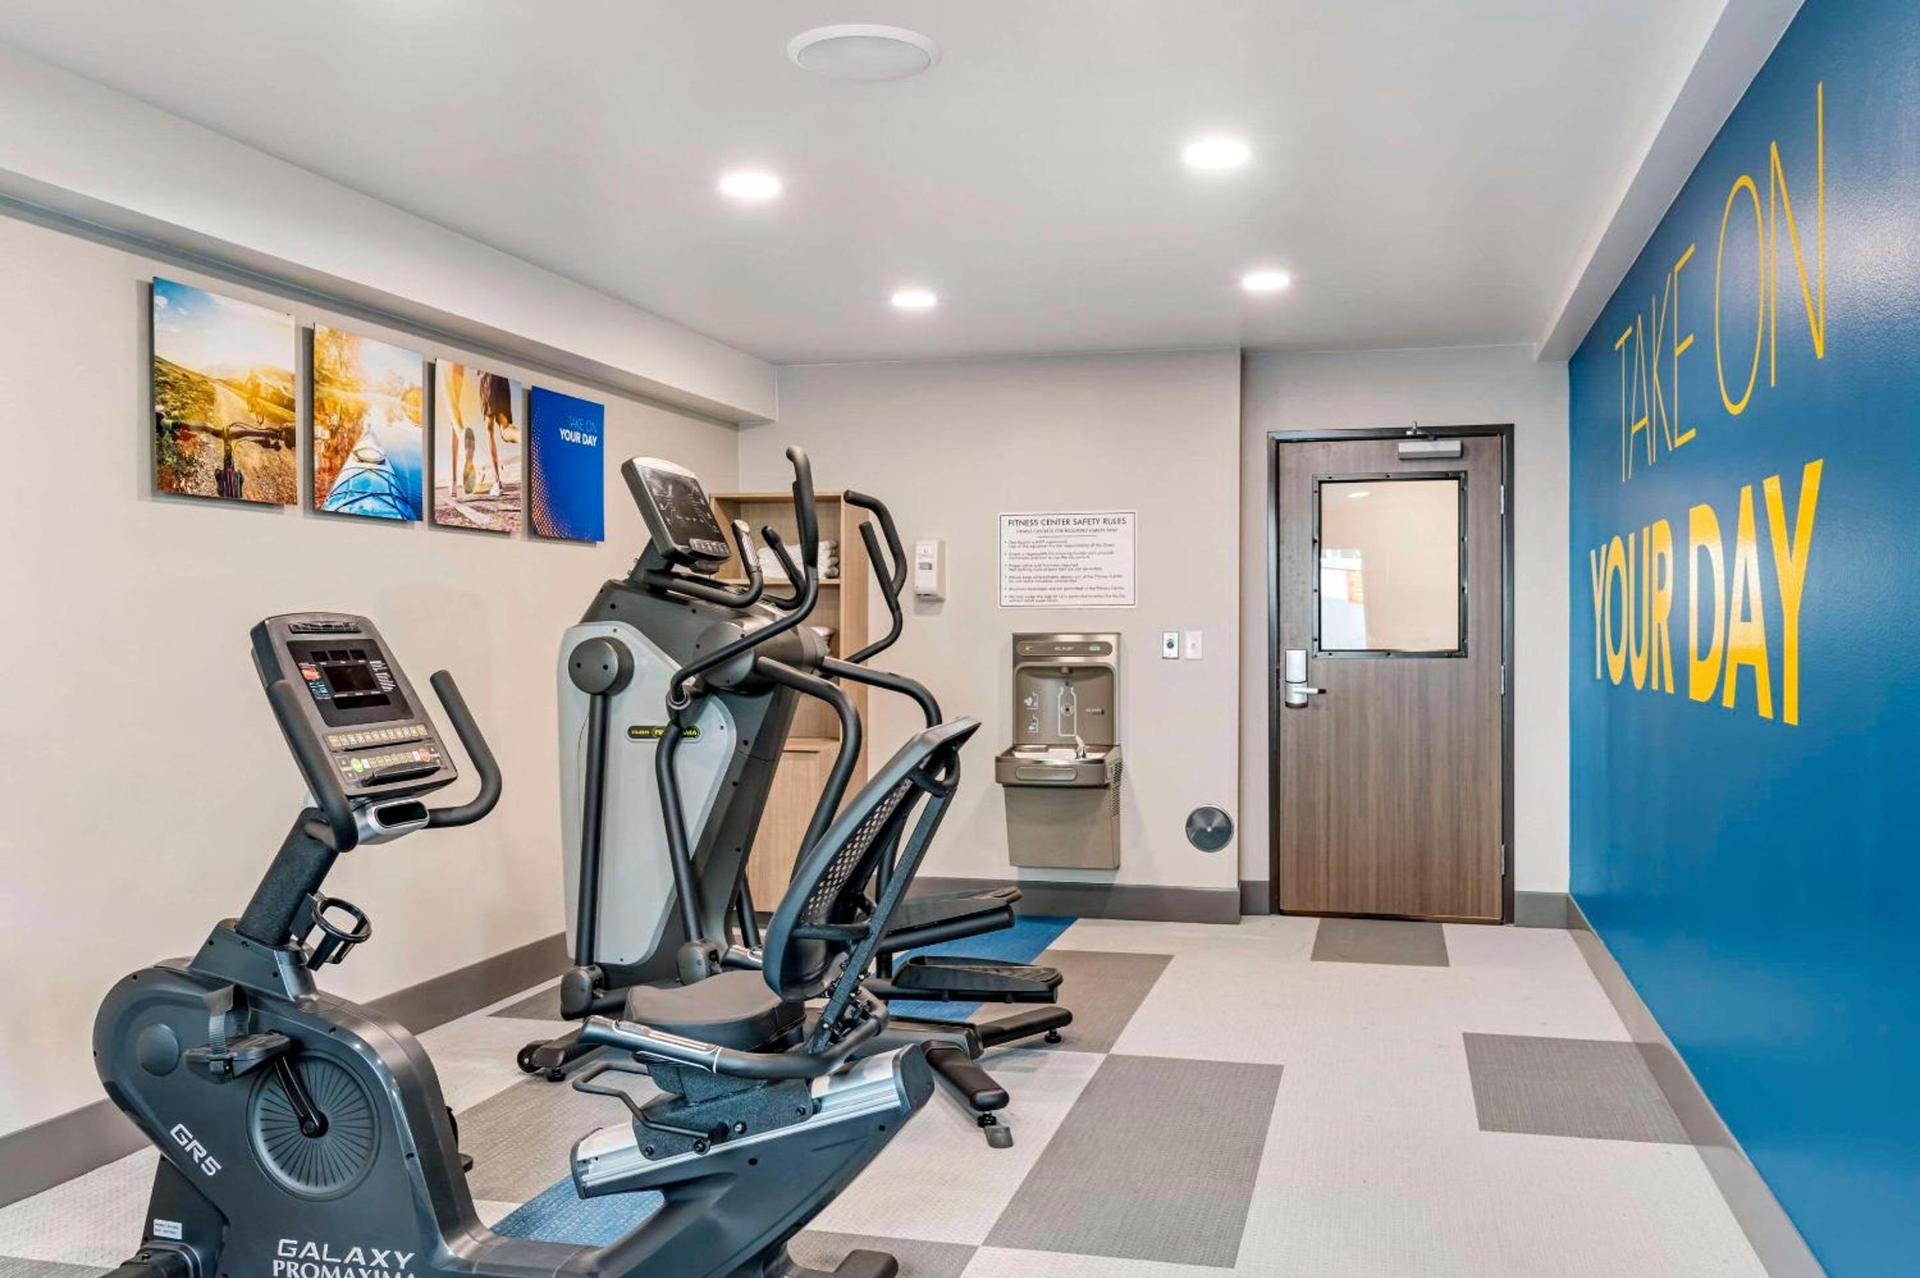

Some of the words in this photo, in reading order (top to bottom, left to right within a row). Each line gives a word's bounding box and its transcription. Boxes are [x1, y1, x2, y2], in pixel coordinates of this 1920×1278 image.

[1615, 243, 1696, 483] TAKE
[1715, 81, 1824, 415] ON
[560, 428, 581, 444] YOUR
[582, 433, 597, 447] DAY
[1008, 519, 1038, 527] FITNESS
[1040, 518, 1070, 526] CENTER
[1073, 518, 1100, 526] SAFETY
[1103, 517, 1127, 525] RULES
[1590, 518, 1675, 695] YOUR
[1688, 459, 1824, 726] DAY
[277, 1238, 415, 1270] GALAXY
